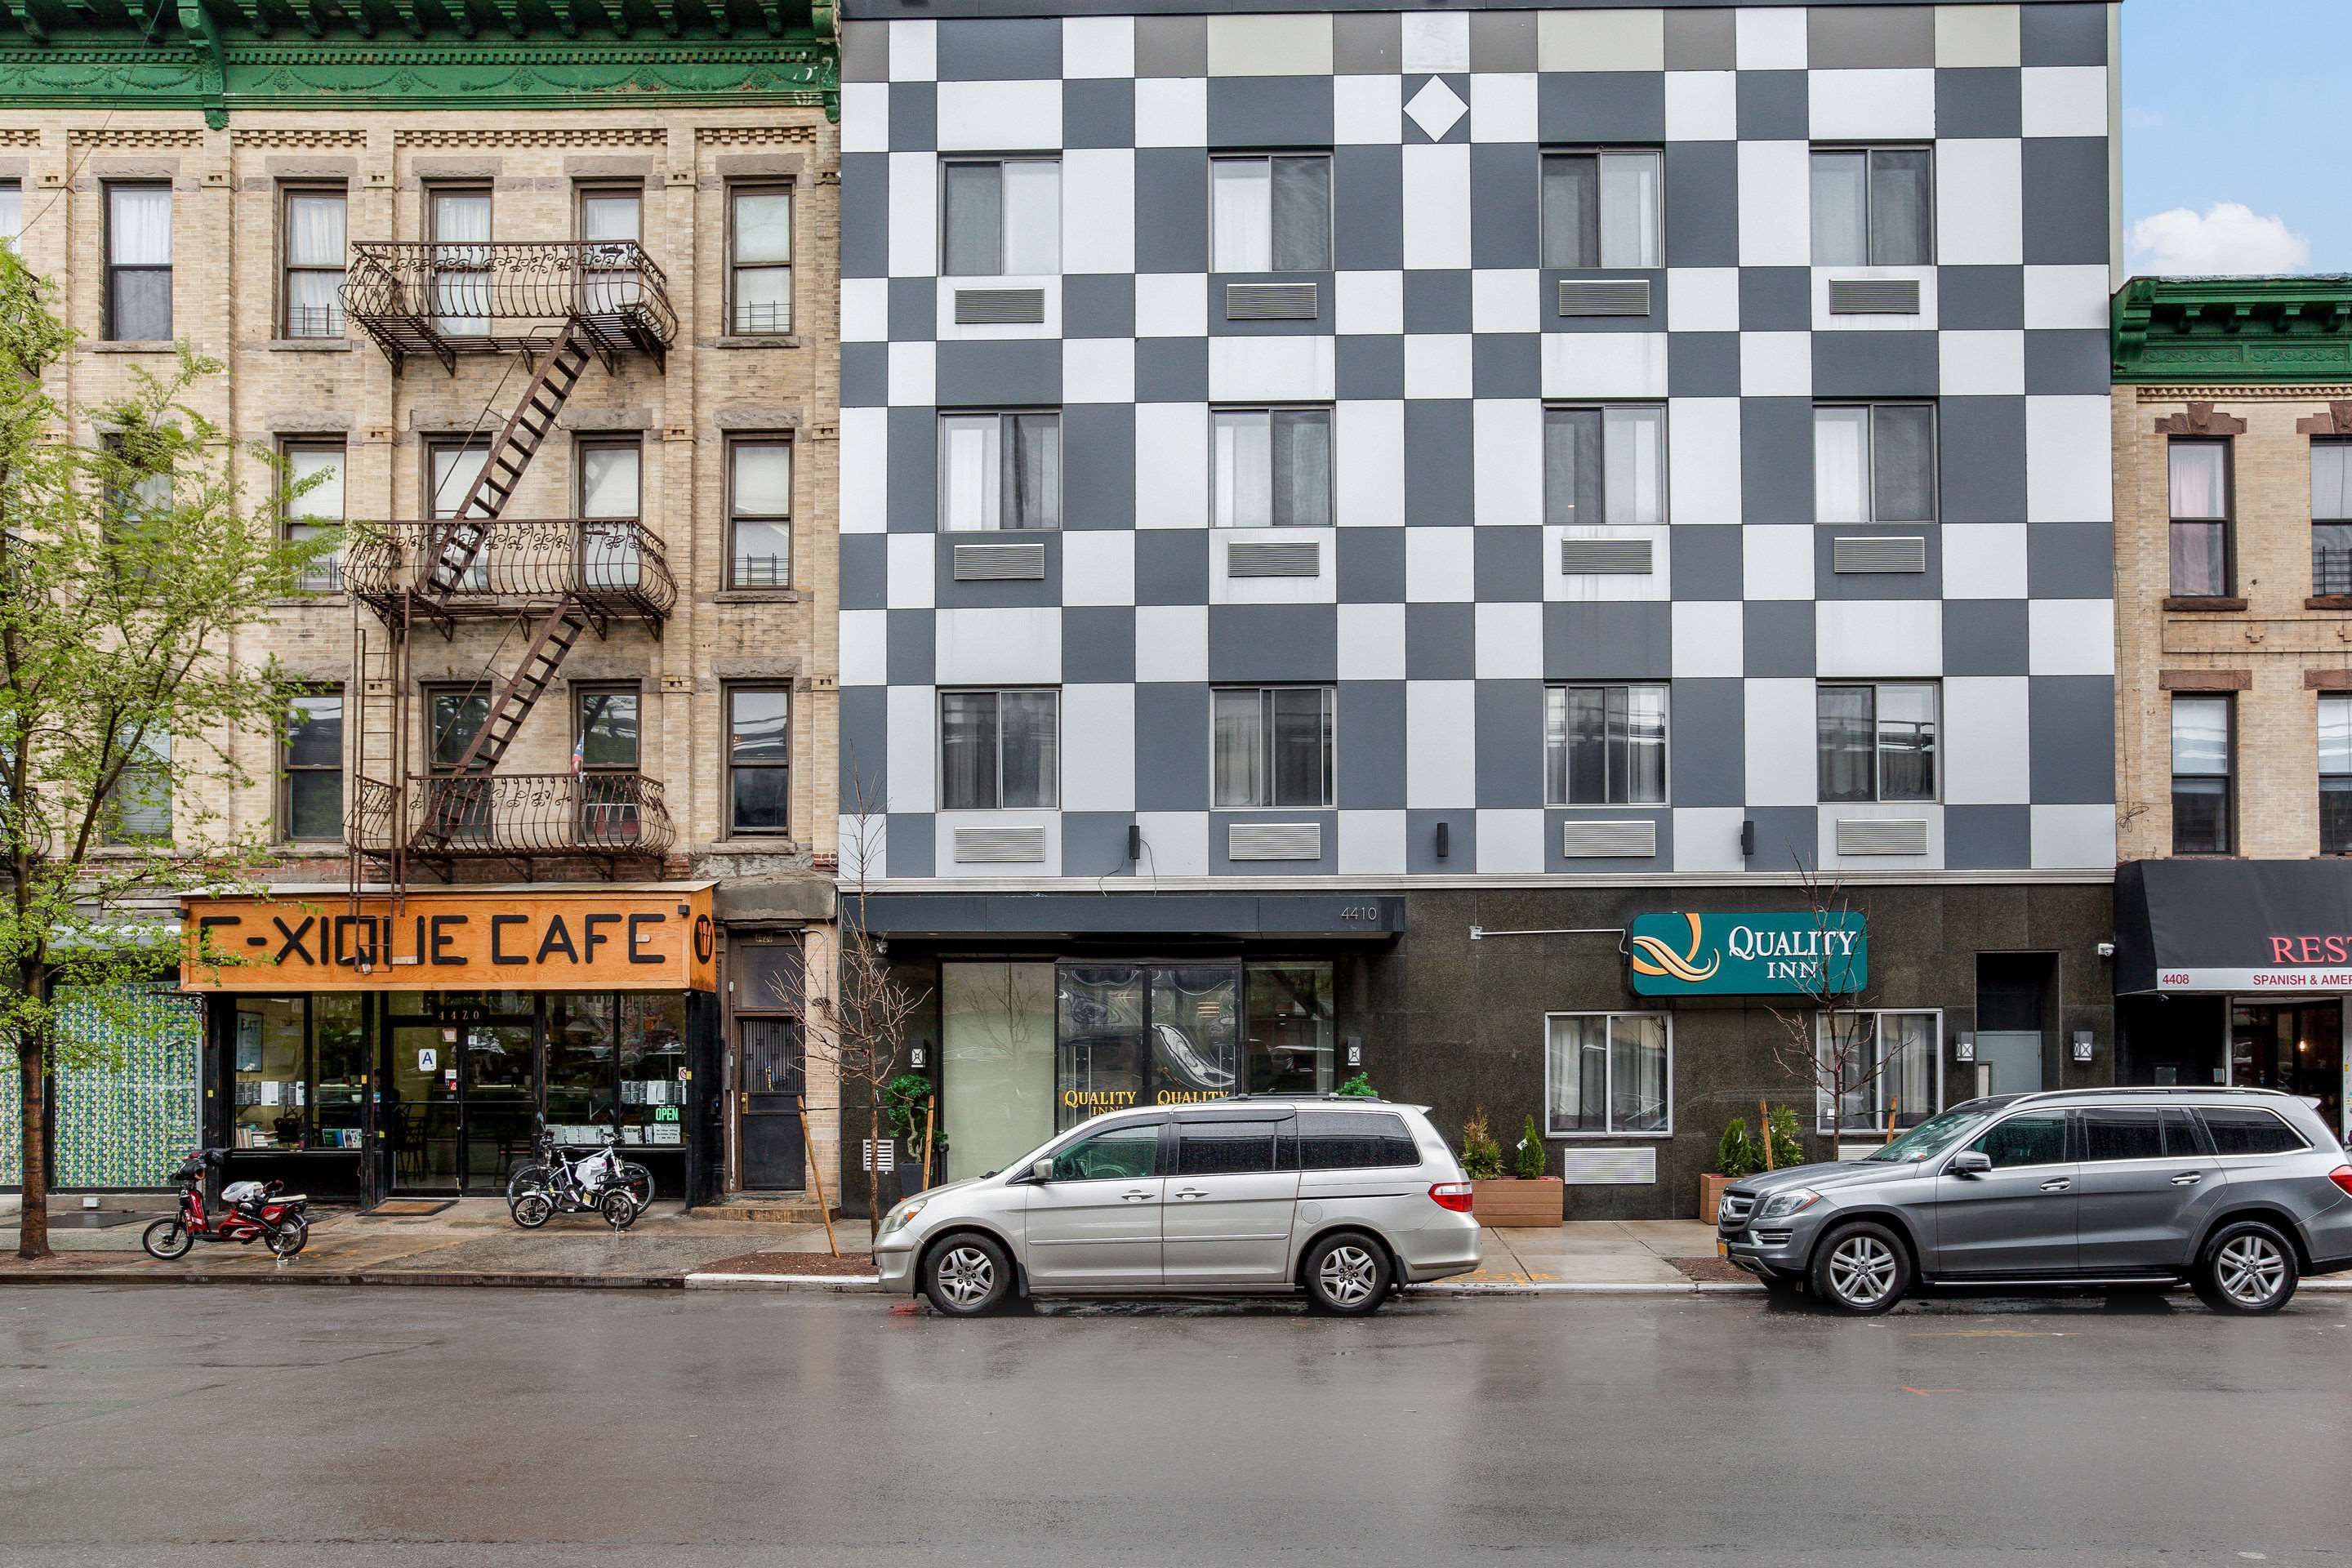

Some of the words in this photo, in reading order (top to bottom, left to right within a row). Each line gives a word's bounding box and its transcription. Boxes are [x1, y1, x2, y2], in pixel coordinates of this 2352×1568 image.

[1341, 906, 1377, 920] 4410
[492, 913, 666, 964] CAFE
[1728, 925, 1857, 961] QUALITY
[1766, 961, 1818, 979] INN
[2162, 973, 2189, 985] 4408
[2253, 974, 2306, 986] SPANISH
[2310, 974, 2319, 985] &
[421, 1051, 434, 1065] A
[1064, 1090, 1137, 1108] QUALITY
[655, 1107, 679, 1121] OPEN
